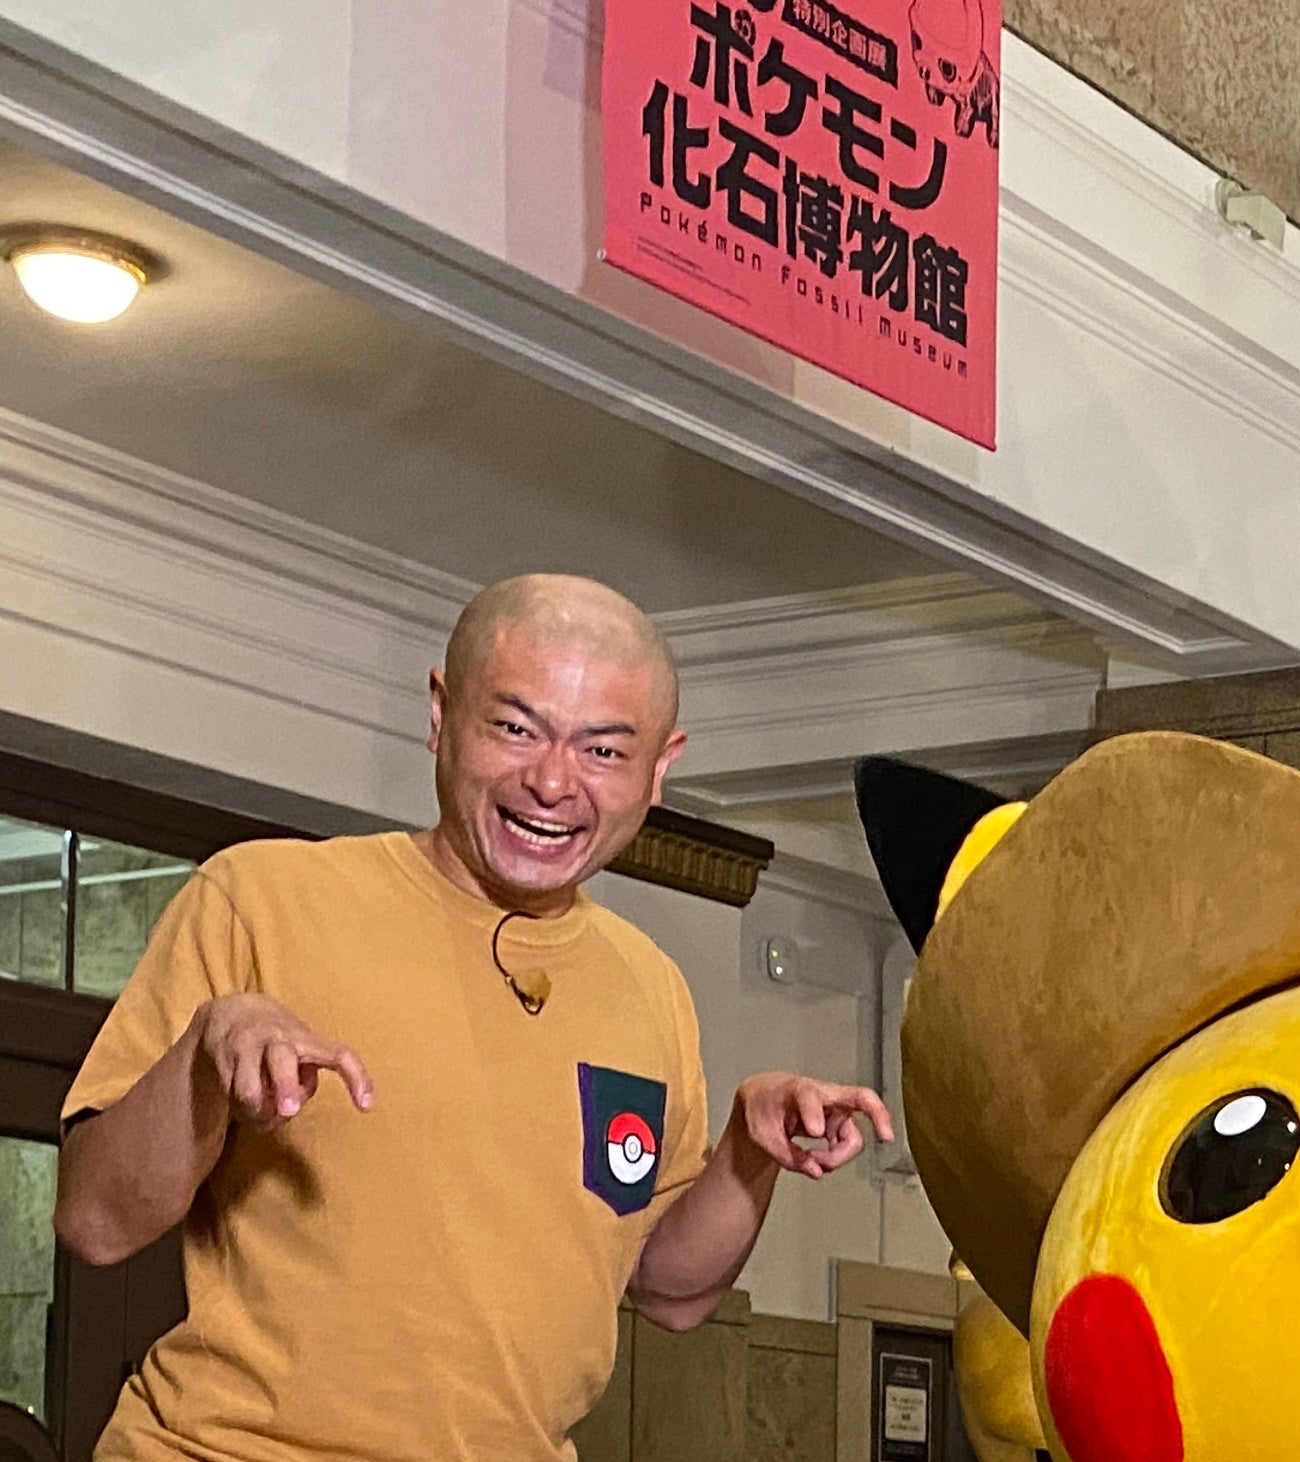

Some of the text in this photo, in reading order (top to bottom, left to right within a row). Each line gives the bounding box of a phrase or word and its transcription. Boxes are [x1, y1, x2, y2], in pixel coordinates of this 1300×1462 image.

[642, 78, 969, 349] 化石博物館
[690, 1, 948, 210] ポケモン
